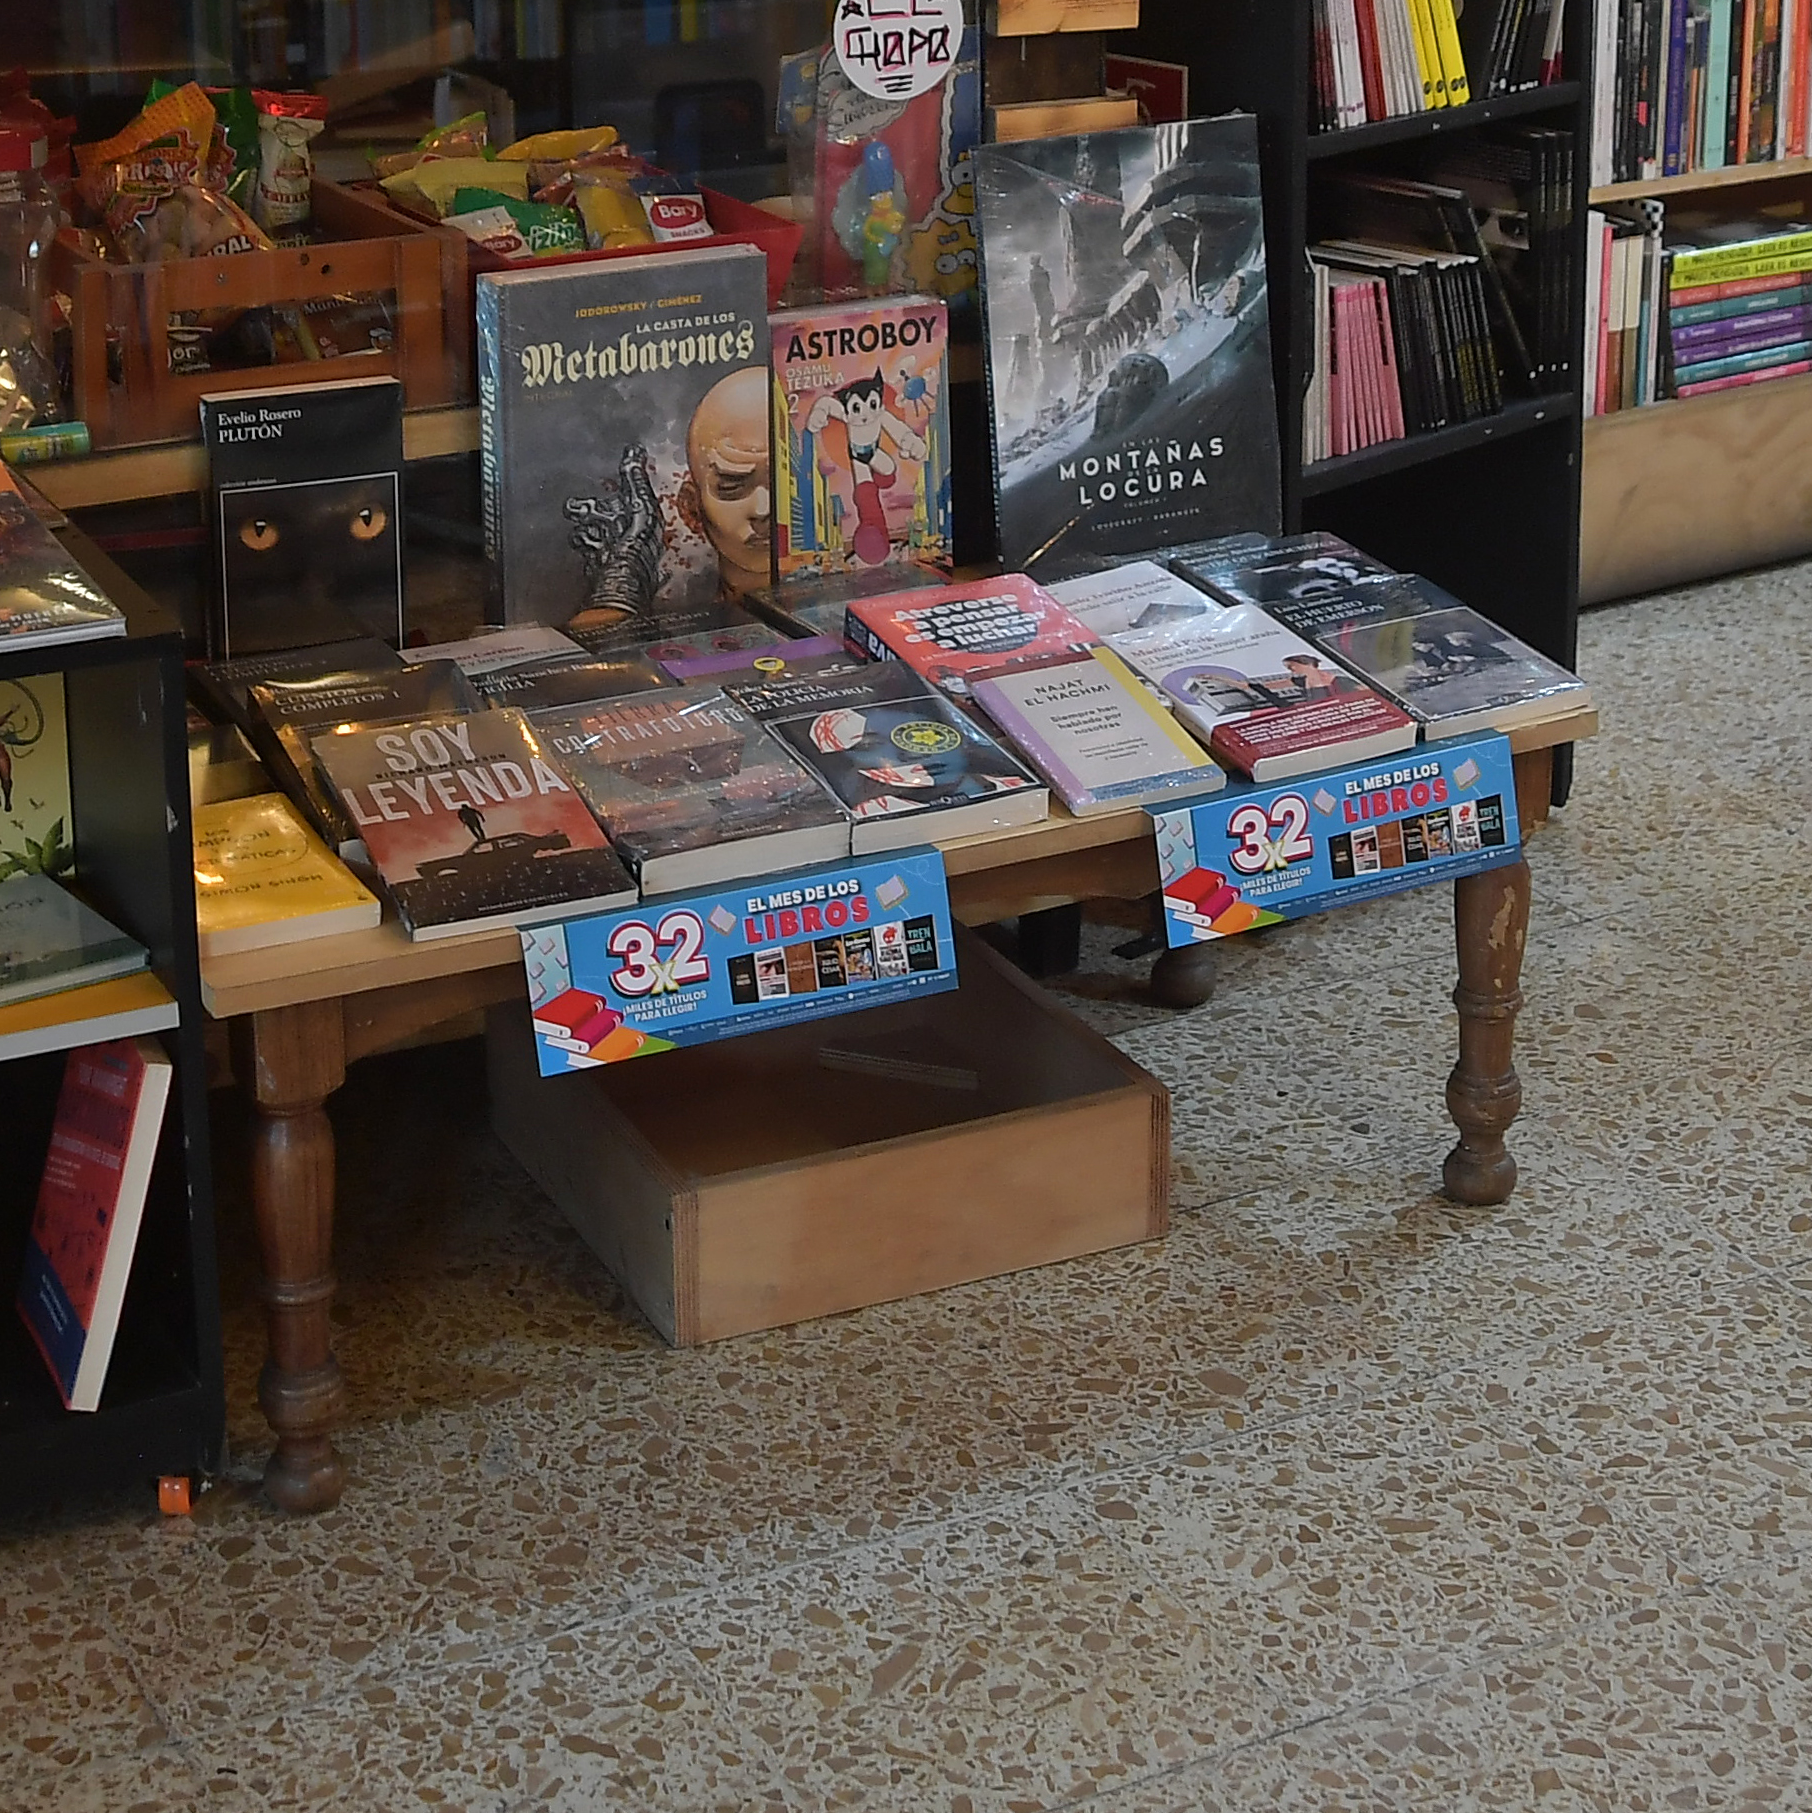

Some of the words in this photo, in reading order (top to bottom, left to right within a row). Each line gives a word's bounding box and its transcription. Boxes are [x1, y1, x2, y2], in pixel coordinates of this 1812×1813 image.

[656, 201, 699, 222] Bary
[576, 301, 647, 318] JODOROWSKY
[636, 324, 651, 334] LA
[653, 317, 692, 332] CASTA
[695, 315, 710, 326] DE
[713, 312, 735, 324] LOS
[785, 315, 937, 364] ASTROBOY
[521, 319, 756, 388] Metabarones
[787, 364, 831, 375] OSAMU
[787, 372, 844, 388] TEZUKA
[787, 394, 799, 415] 2
[217, 409, 255, 428] Evelio
[259, 406, 302, 423] Rosero
[217, 422, 284, 445] PLUTÓN
[1059, 437, 1224, 481] MONTAÑAS
[1079, 468, 1207, 505] LOCURA
[894, 593, 1019, 622] Atreverse
[931, 604, 1021, 628] pensar
[954, 625, 1037, 645] luchar
[274, 689, 359, 708] CUENTOS
[795, 684, 874, 707] MEMORIA
[1024, 697, 1042, 707] EL
[1046, 682, 1111, 704] HACHMI
[1035, 680, 1084, 695] NAJAT
[279, 693, 385, 716] COMPLETOS
[1049, 708, 1095, 724] Siempre
[1097, 705, 1118, 716] han
[1057, 715, 1102, 731] hablado
[1104, 713, 1122, 726] por
[1074, 721, 1121, 736] nosotras
[376, 721, 477, 773] SOY
[1345, 781, 1362, 795] EL
[1363, 773, 1393, 790] MES
[1395, 769, 1414, 785] DE
[1415, 762, 1439, 779] LOS
[341, 756, 571, 827] LEYENDA
[1342, 777, 1449, 824] LIBROS
[1268, 874, 1278, 885] DE
[747, 897, 768, 913] EL
[769, 890, 803, 909] MES
[806, 886, 825, 903] DE
[827, 879, 859, 897] LOS
[1249, 885, 1273, 897] PARA
[742, 895, 871, 946] LIBROS
[655, 995, 670, 1009] DE
[671, 990, 707, 1006] TÍTULOS
[635, 1008, 661, 1023] PARA
